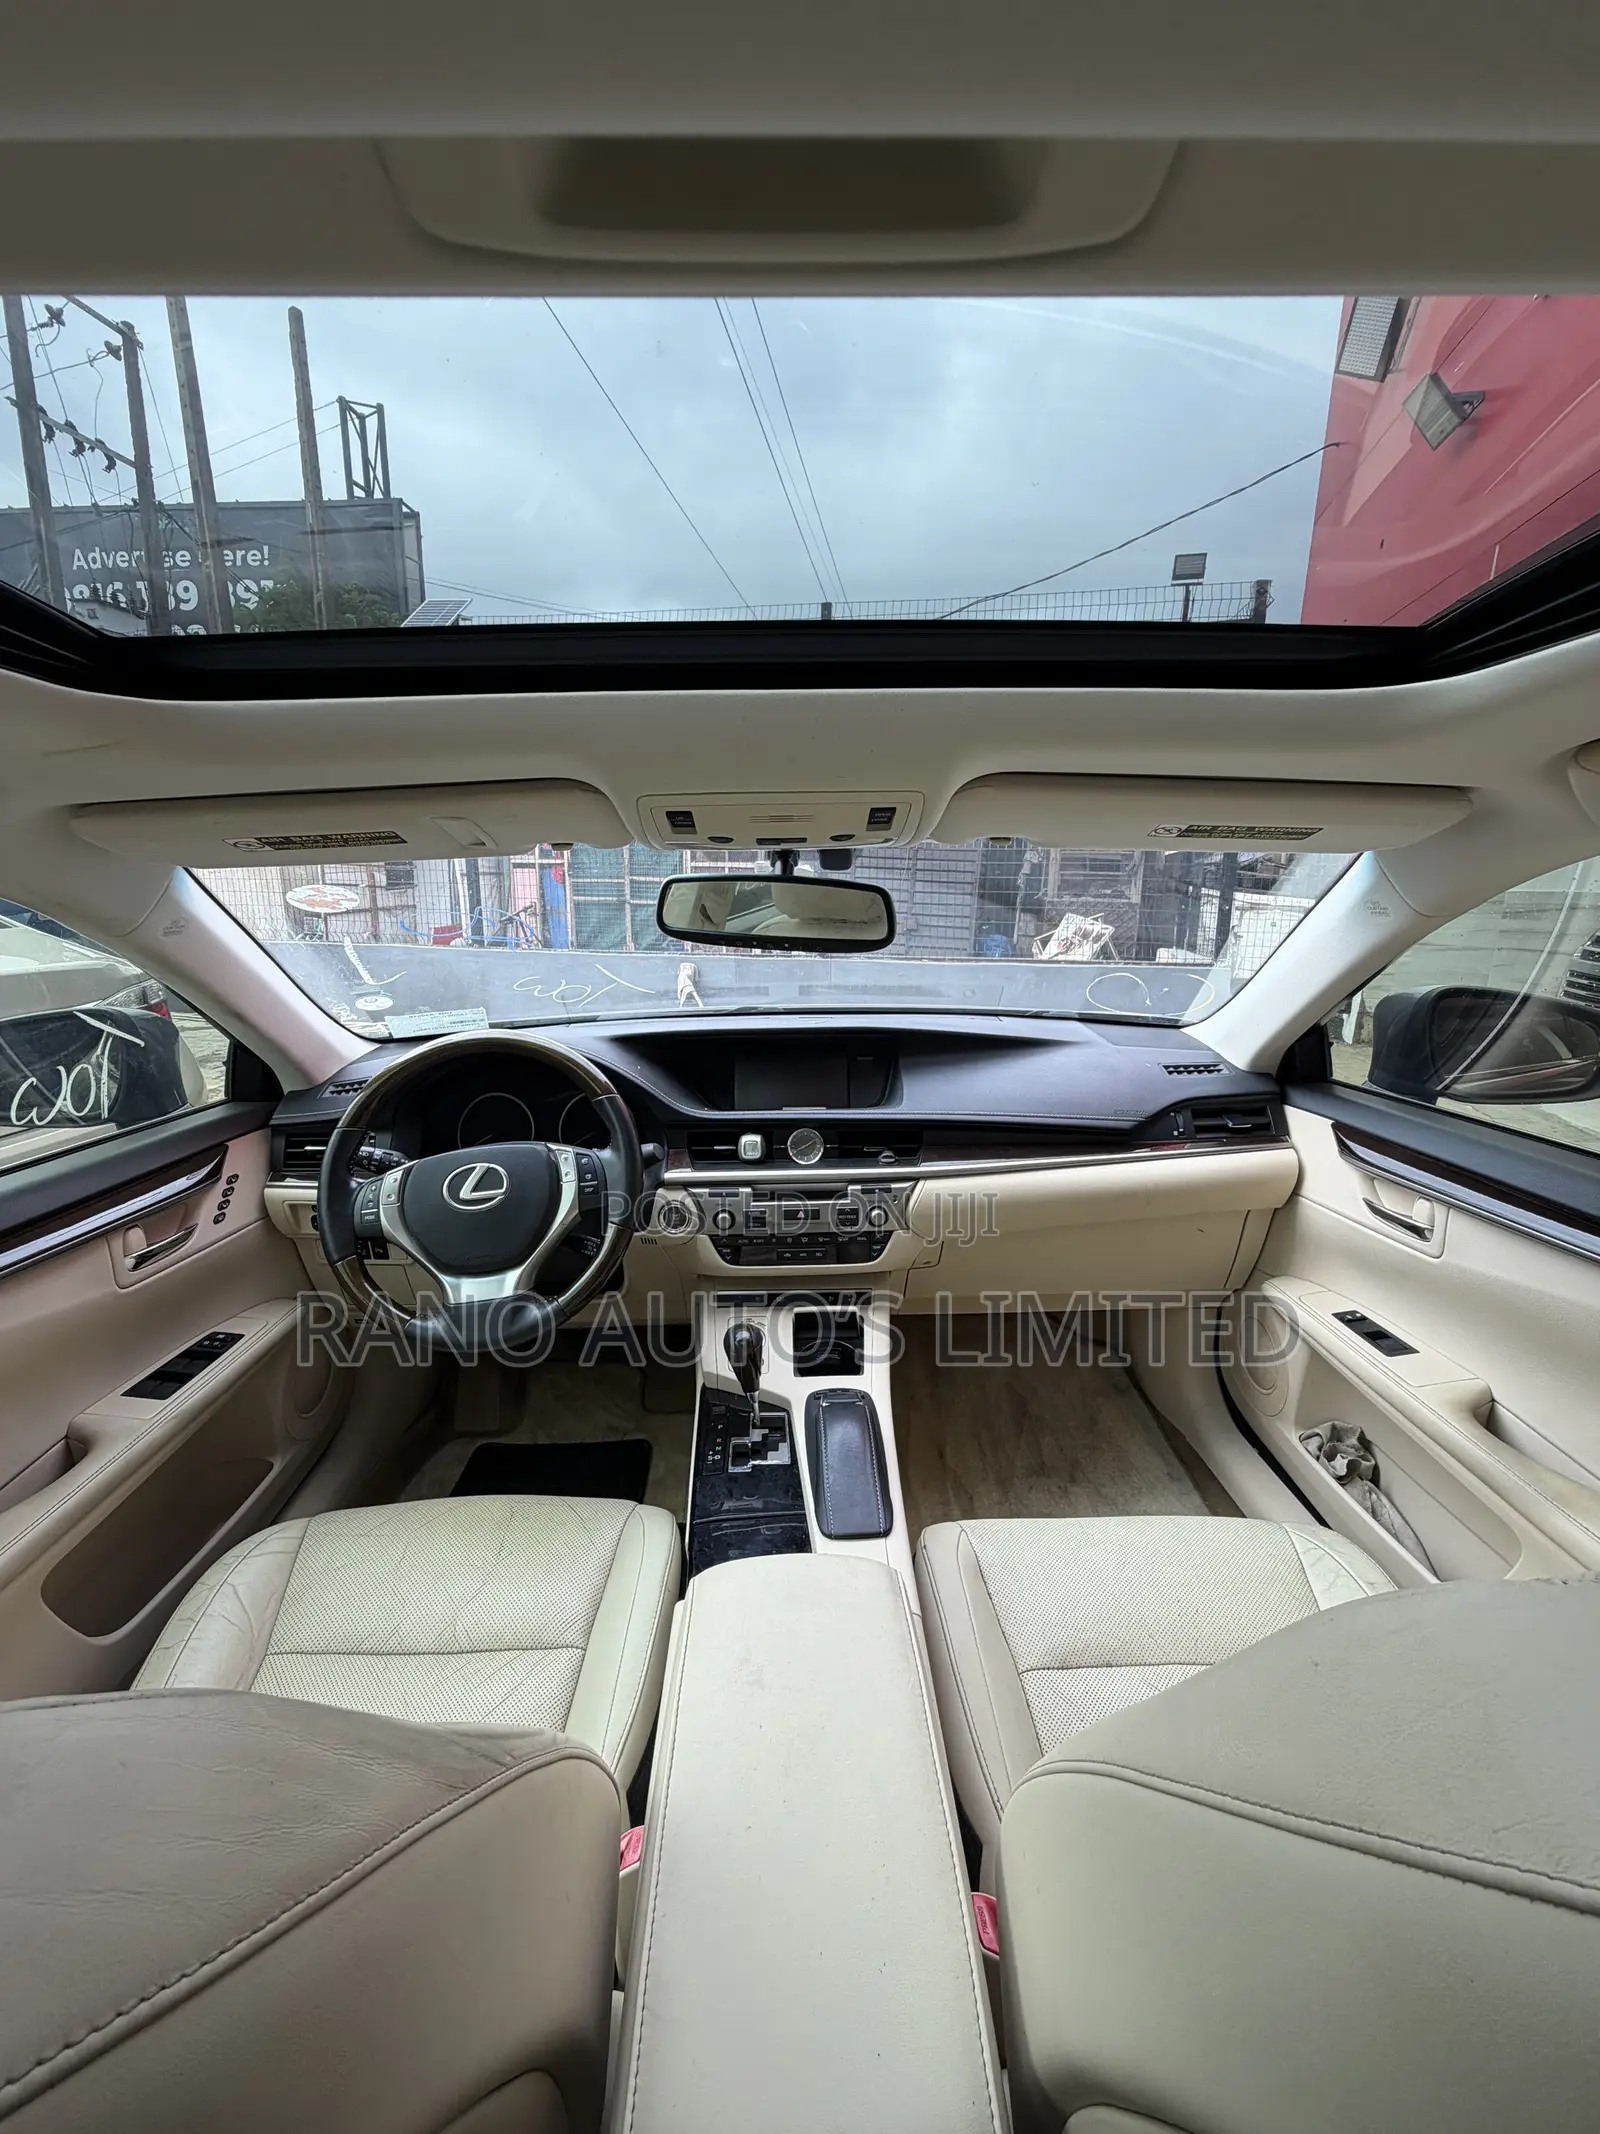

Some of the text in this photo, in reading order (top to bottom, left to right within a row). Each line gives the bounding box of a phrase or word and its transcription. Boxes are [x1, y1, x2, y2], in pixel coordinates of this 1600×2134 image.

[72, 545, 270, 571] Advertse ere!
[328, 831, 396, 840] WARNING
